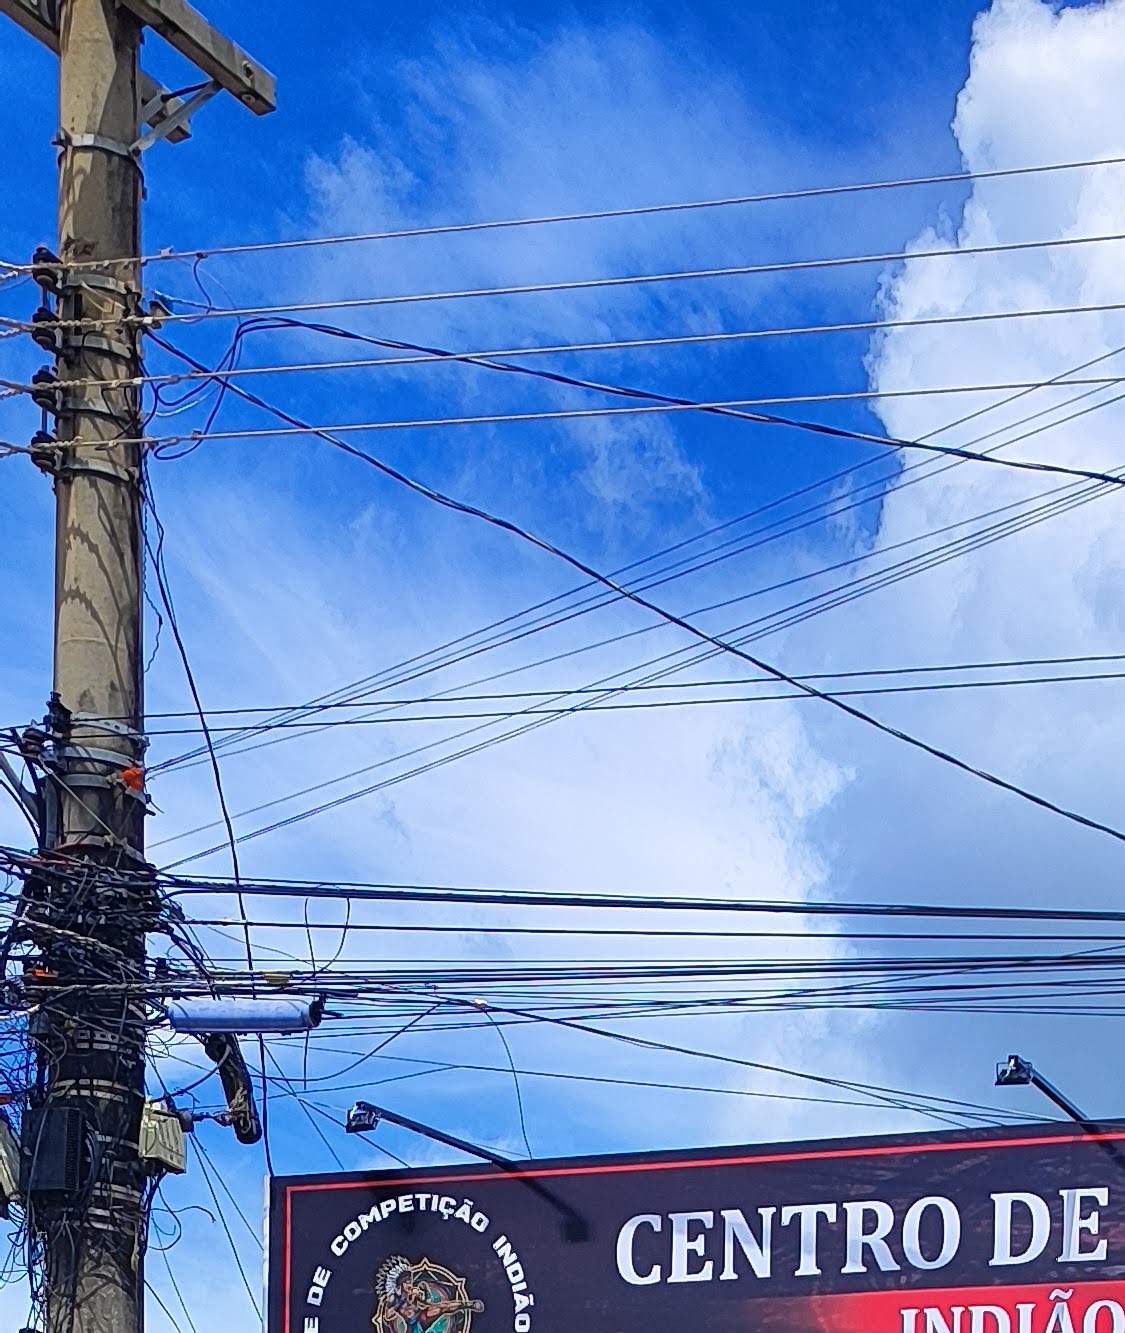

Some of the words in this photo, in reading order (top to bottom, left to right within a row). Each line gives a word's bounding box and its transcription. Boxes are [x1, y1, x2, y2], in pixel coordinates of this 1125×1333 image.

[307, 1265, 332, 1307] DE
[331, 1193, 490, 1257] COMPETIÇÃO
[492, 1235, 535, 1333] INDIÃO
[615, 1195, 961, 1286] CENTRO
[988, 1186, 1109, 1267] DE
